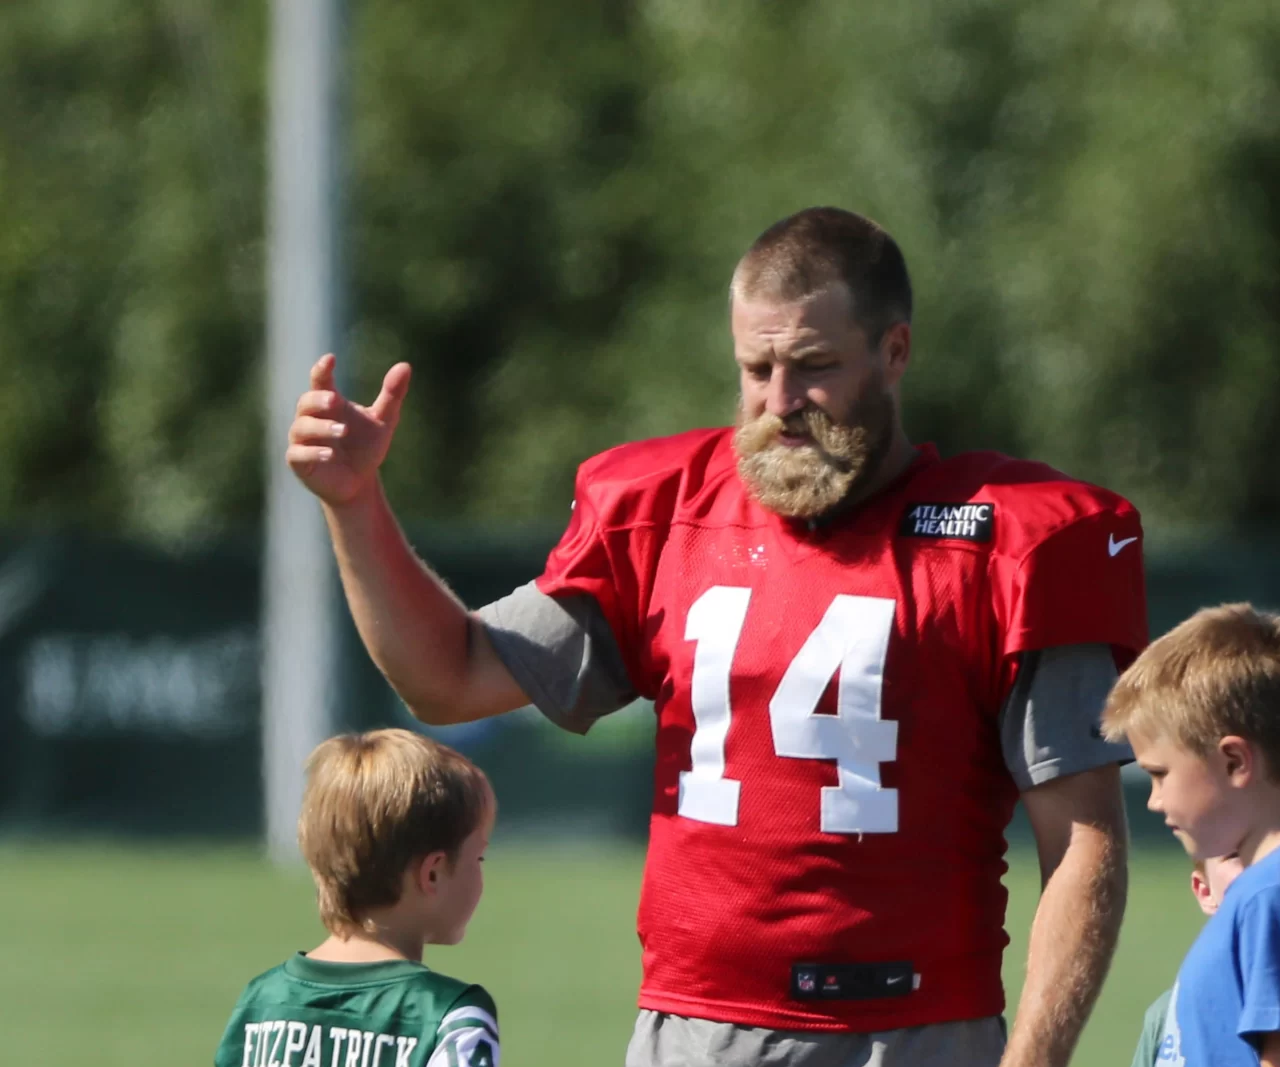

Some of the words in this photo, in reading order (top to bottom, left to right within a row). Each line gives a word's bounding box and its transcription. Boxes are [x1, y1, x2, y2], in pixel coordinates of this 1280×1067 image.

[908, 505, 989, 521] ATLANTIC
[914, 520, 976, 536] HEALTH
[677, 585, 898, 833] 14
